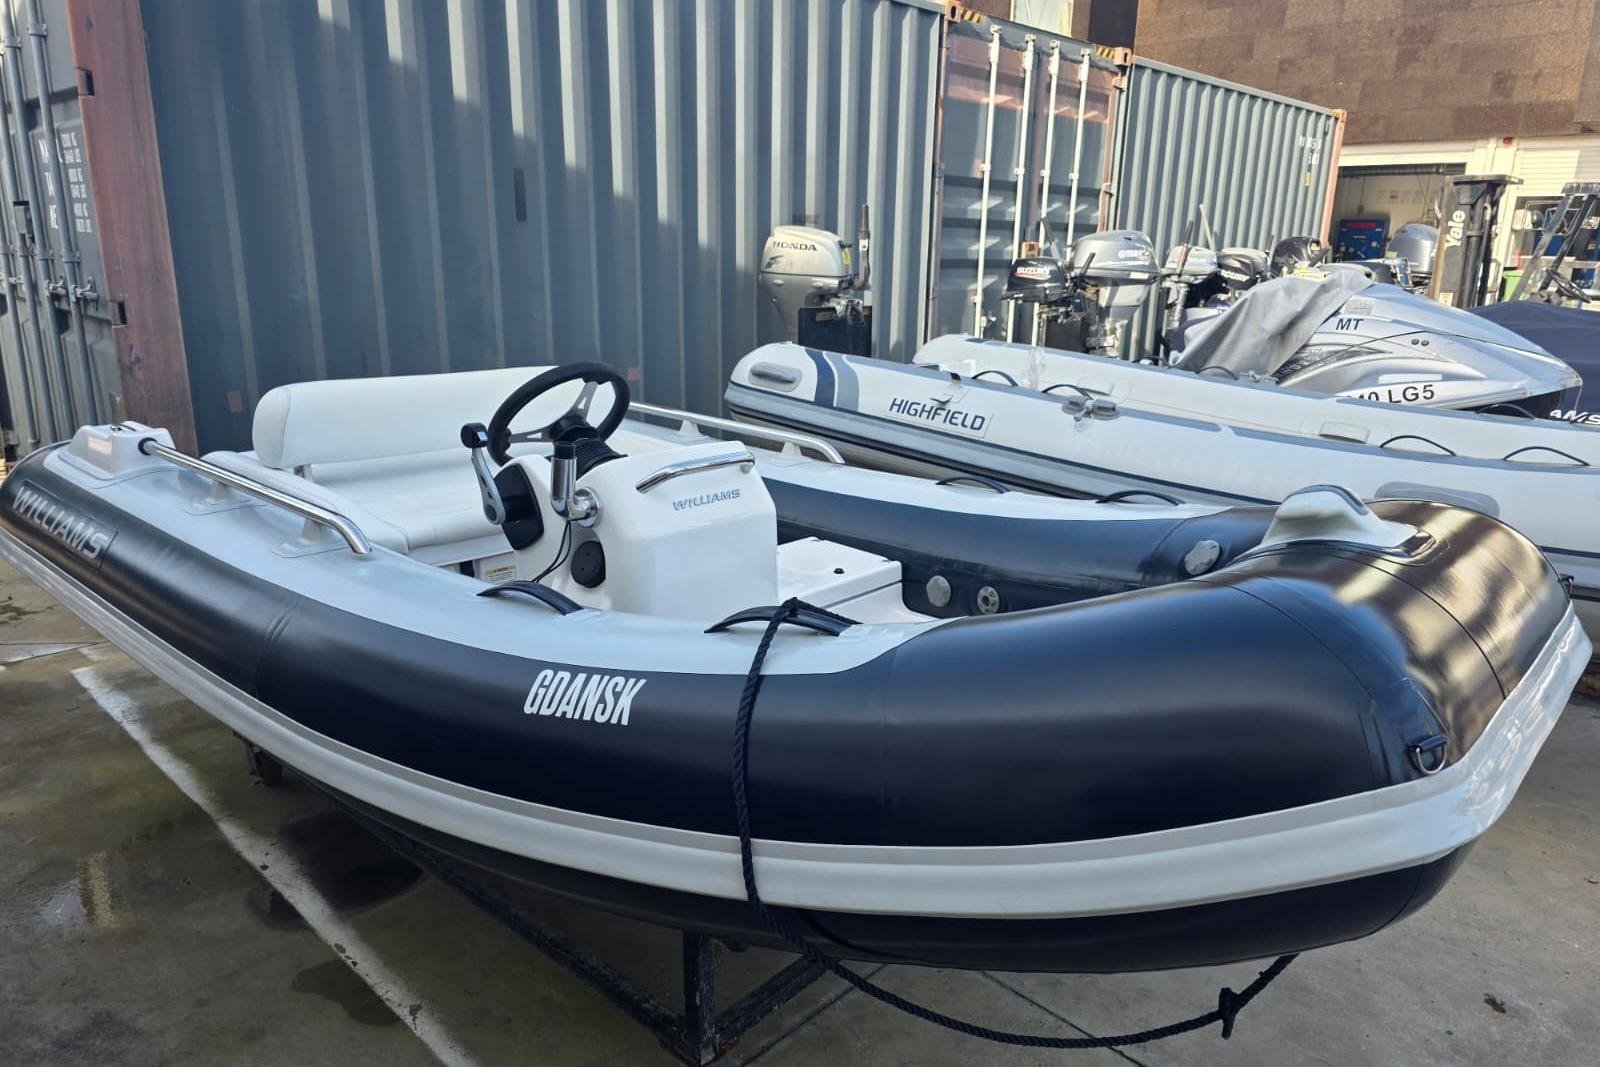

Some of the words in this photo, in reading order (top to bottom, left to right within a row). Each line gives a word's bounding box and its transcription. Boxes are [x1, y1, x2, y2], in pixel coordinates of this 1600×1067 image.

[1445, 210, 1466, 247] Yale
[772, 241, 817, 252] HONDA
[1335, 318, 1363, 331] MT
[1387, 384, 1435, 404] LG5
[889, 397, 986, 431] HIGHFIELD
[672, 488, 741, 512] WILLIAMS
[12, 486, 109, 560] WILLIAMS
[523, 669, 647, 726] GDANSK
